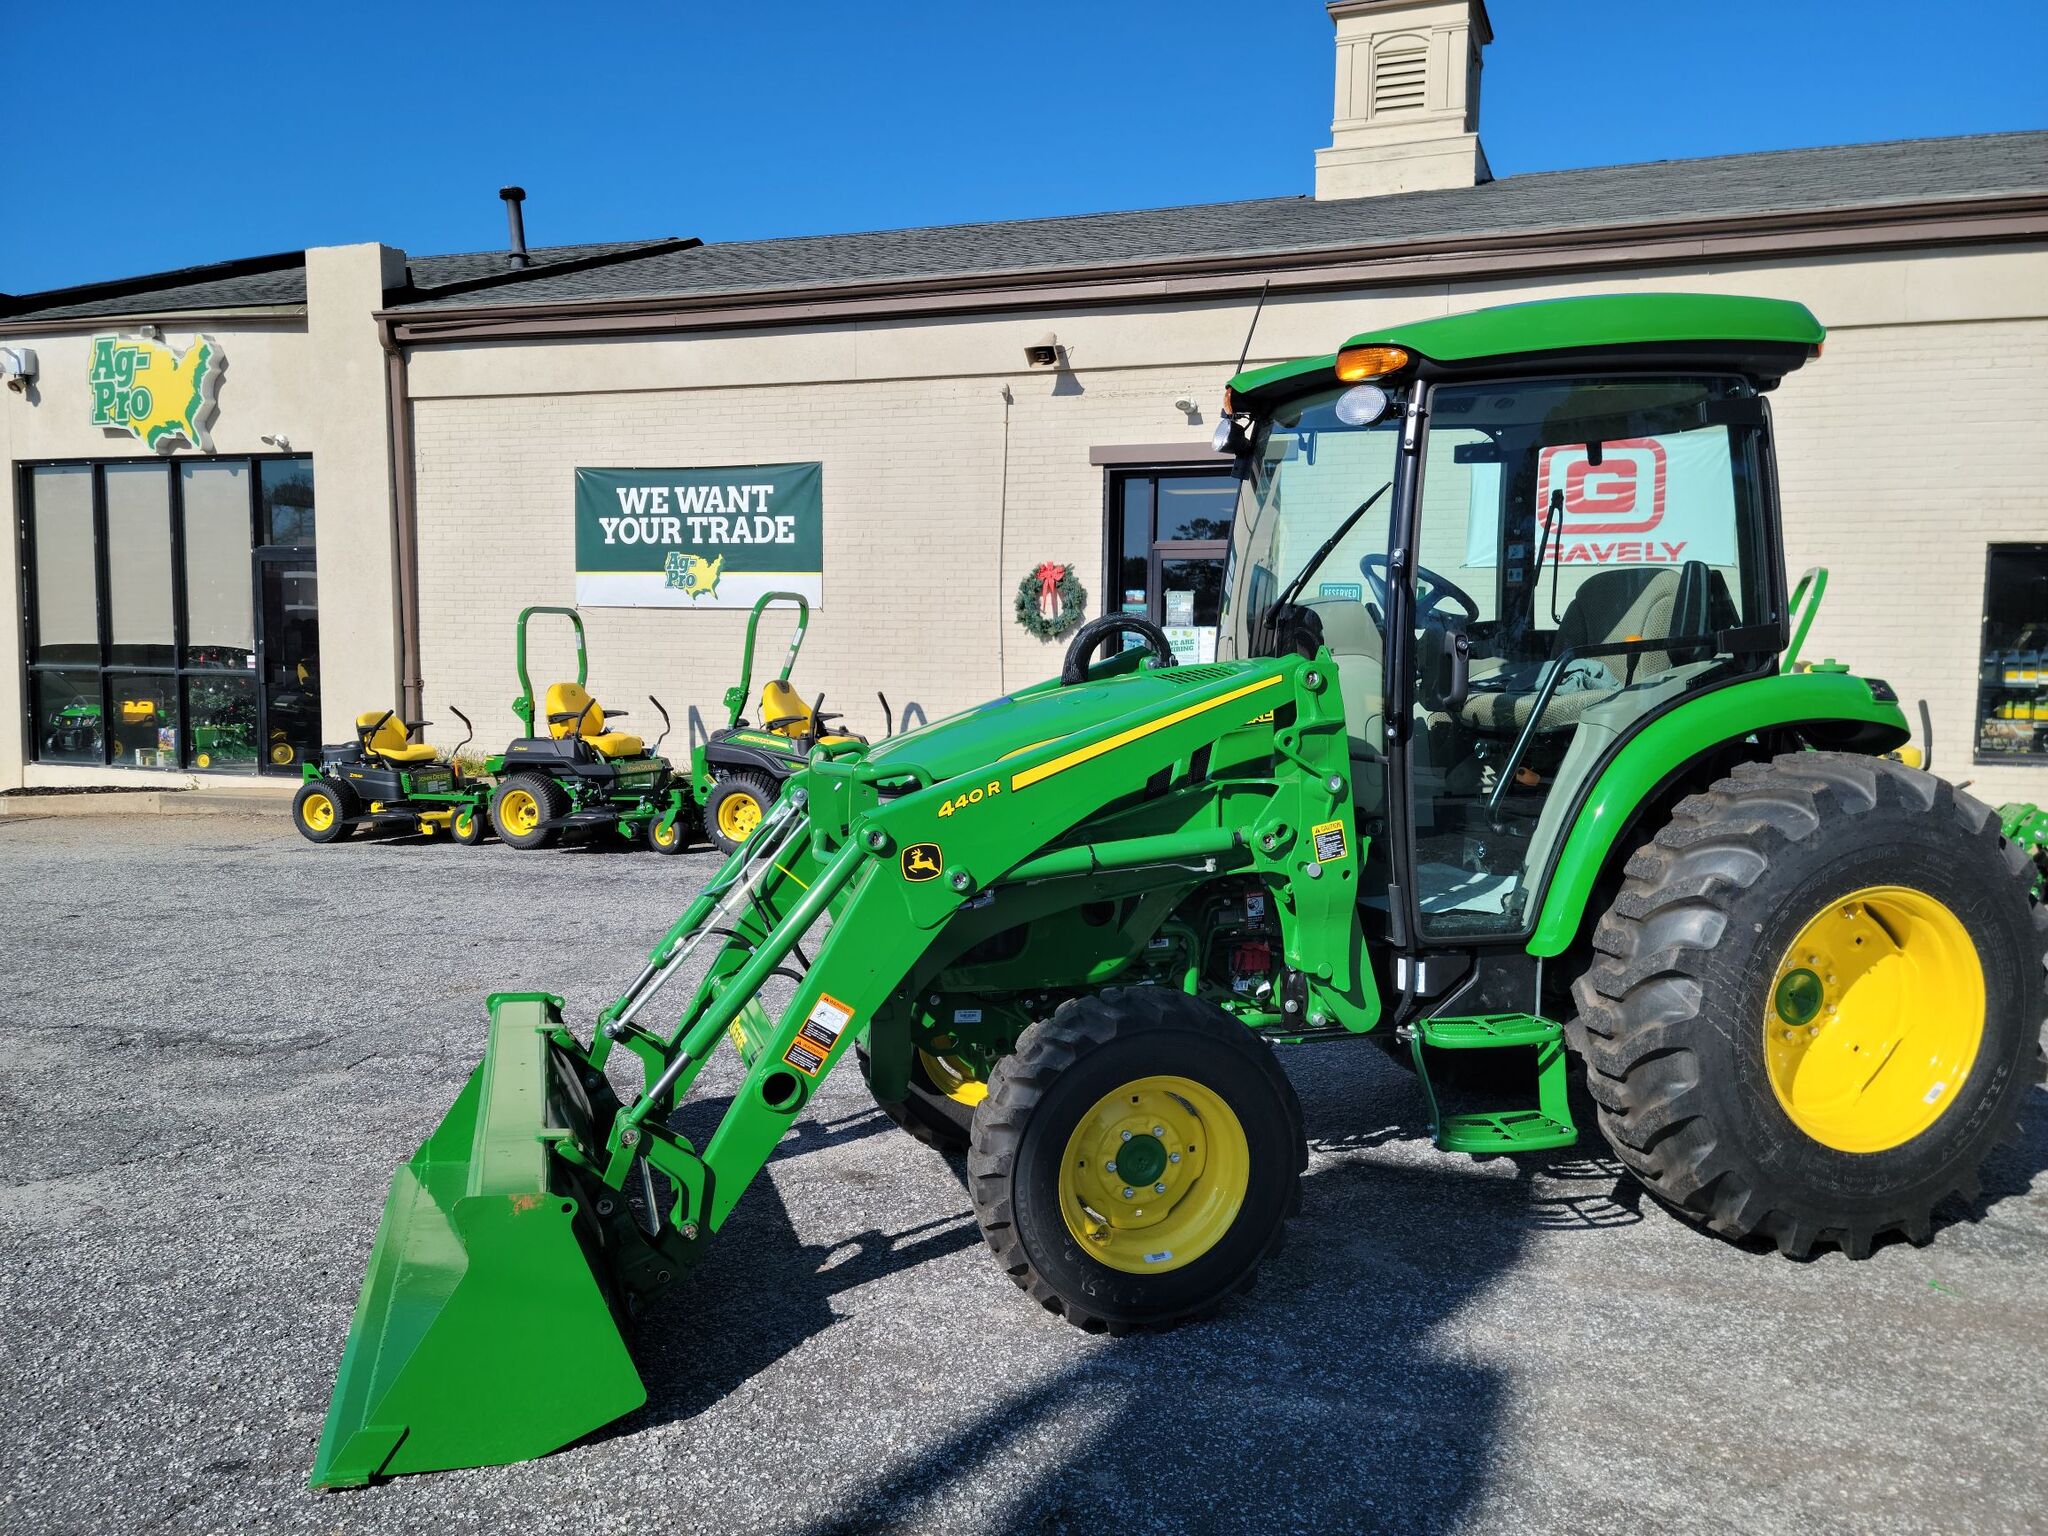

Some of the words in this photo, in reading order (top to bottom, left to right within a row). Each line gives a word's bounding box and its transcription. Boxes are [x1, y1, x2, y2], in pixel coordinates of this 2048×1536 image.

[91, 339, 149, 388] Ag-
[94, 381, 152, 421] Pro
[616, 487, 669, 514] WE
[674, 485, 774, 513] WANT
[599, 517, 682, 544] YOUR
[687, 516, 795, 544] TRADE
[667, 552, 697, 573] Ag-
[1542, 541, 1688, 563] RAVELY
[666, 570, 696, 588] Pro
[1324, 588, 1357, 598] RESERVED
[1320, 822, 1342, 832] CAUTION
[829, 999, 850, 1013] WARNING
[803, 1042, 824, 1057] WARNING
